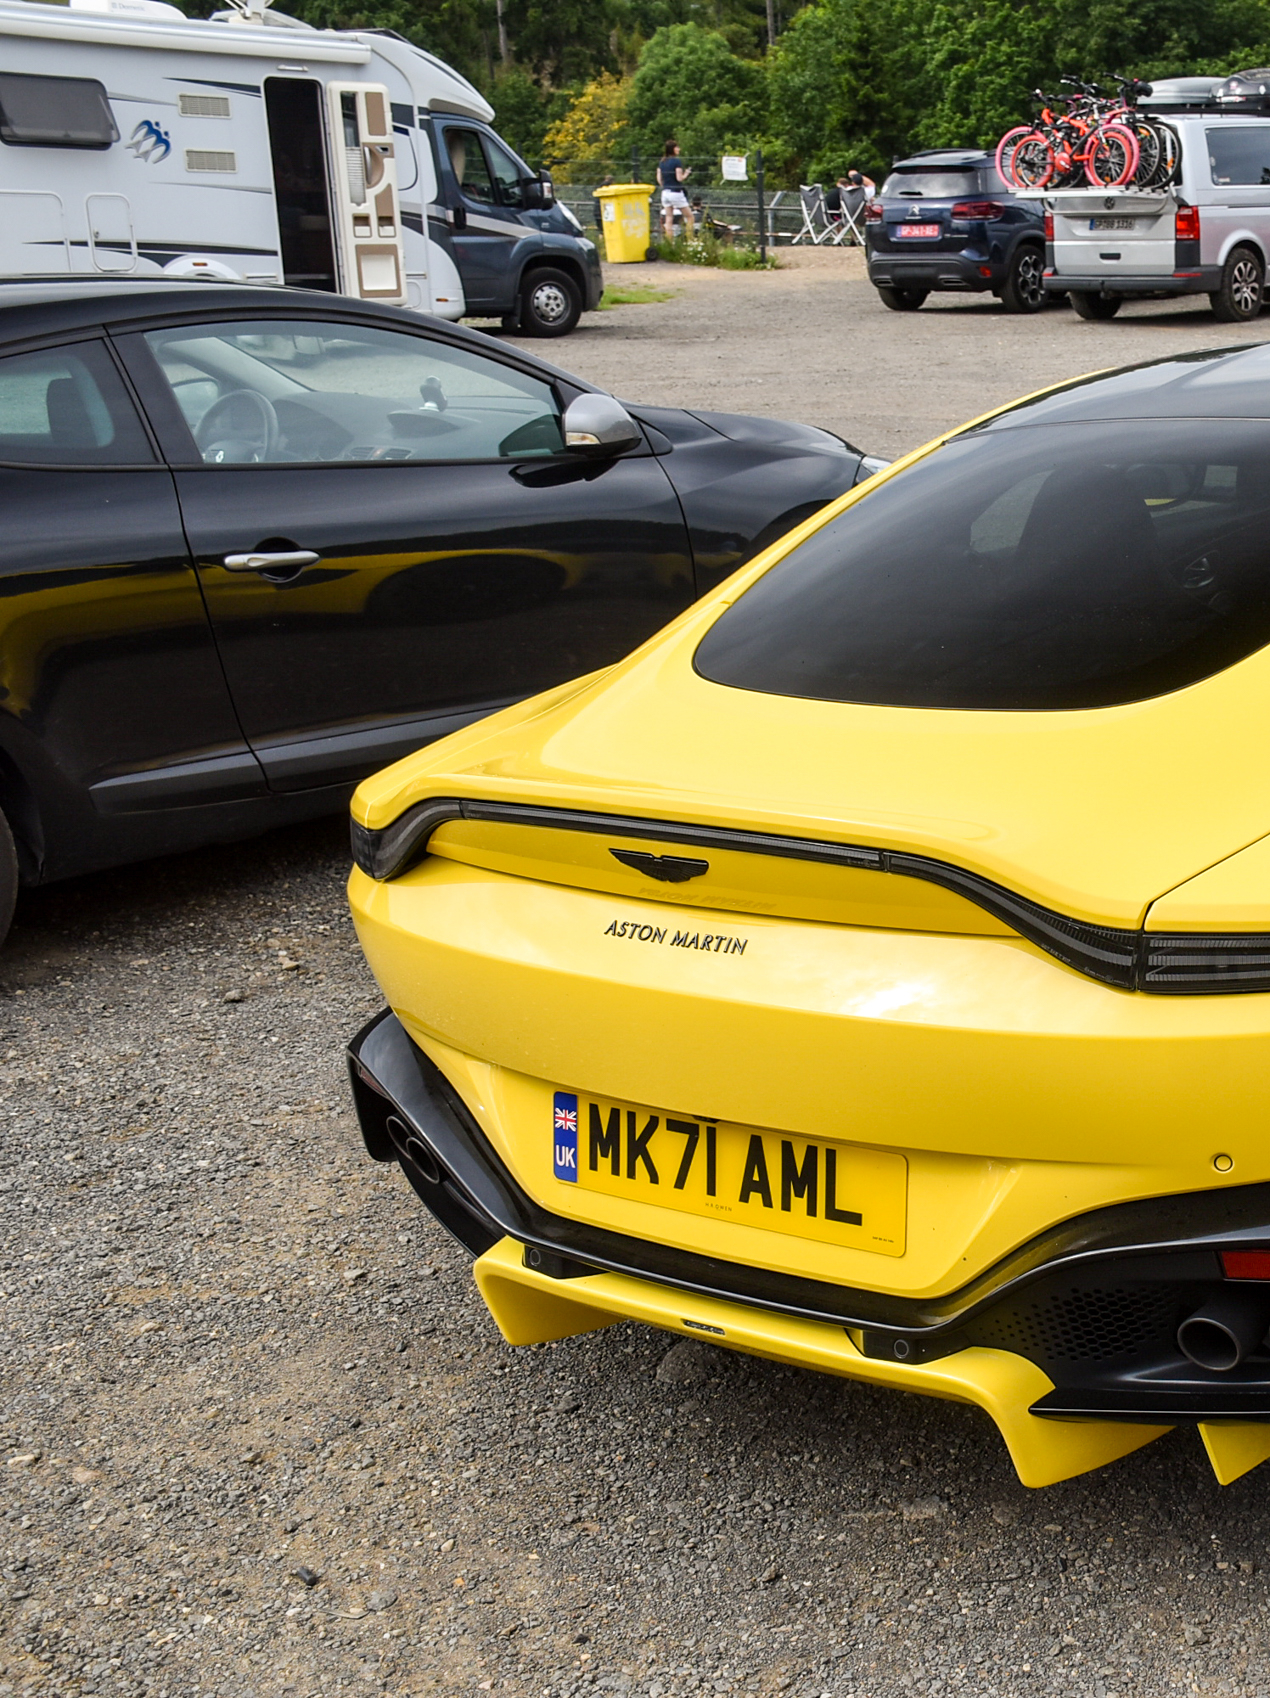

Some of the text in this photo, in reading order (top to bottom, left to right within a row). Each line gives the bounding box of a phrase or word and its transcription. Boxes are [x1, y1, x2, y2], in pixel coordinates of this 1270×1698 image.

[604, 919, 748, 955] ASTON MARTIN
[555, 1144, 576, 1169] UK
[588, 1102, 863, 1227] MK71 AML
